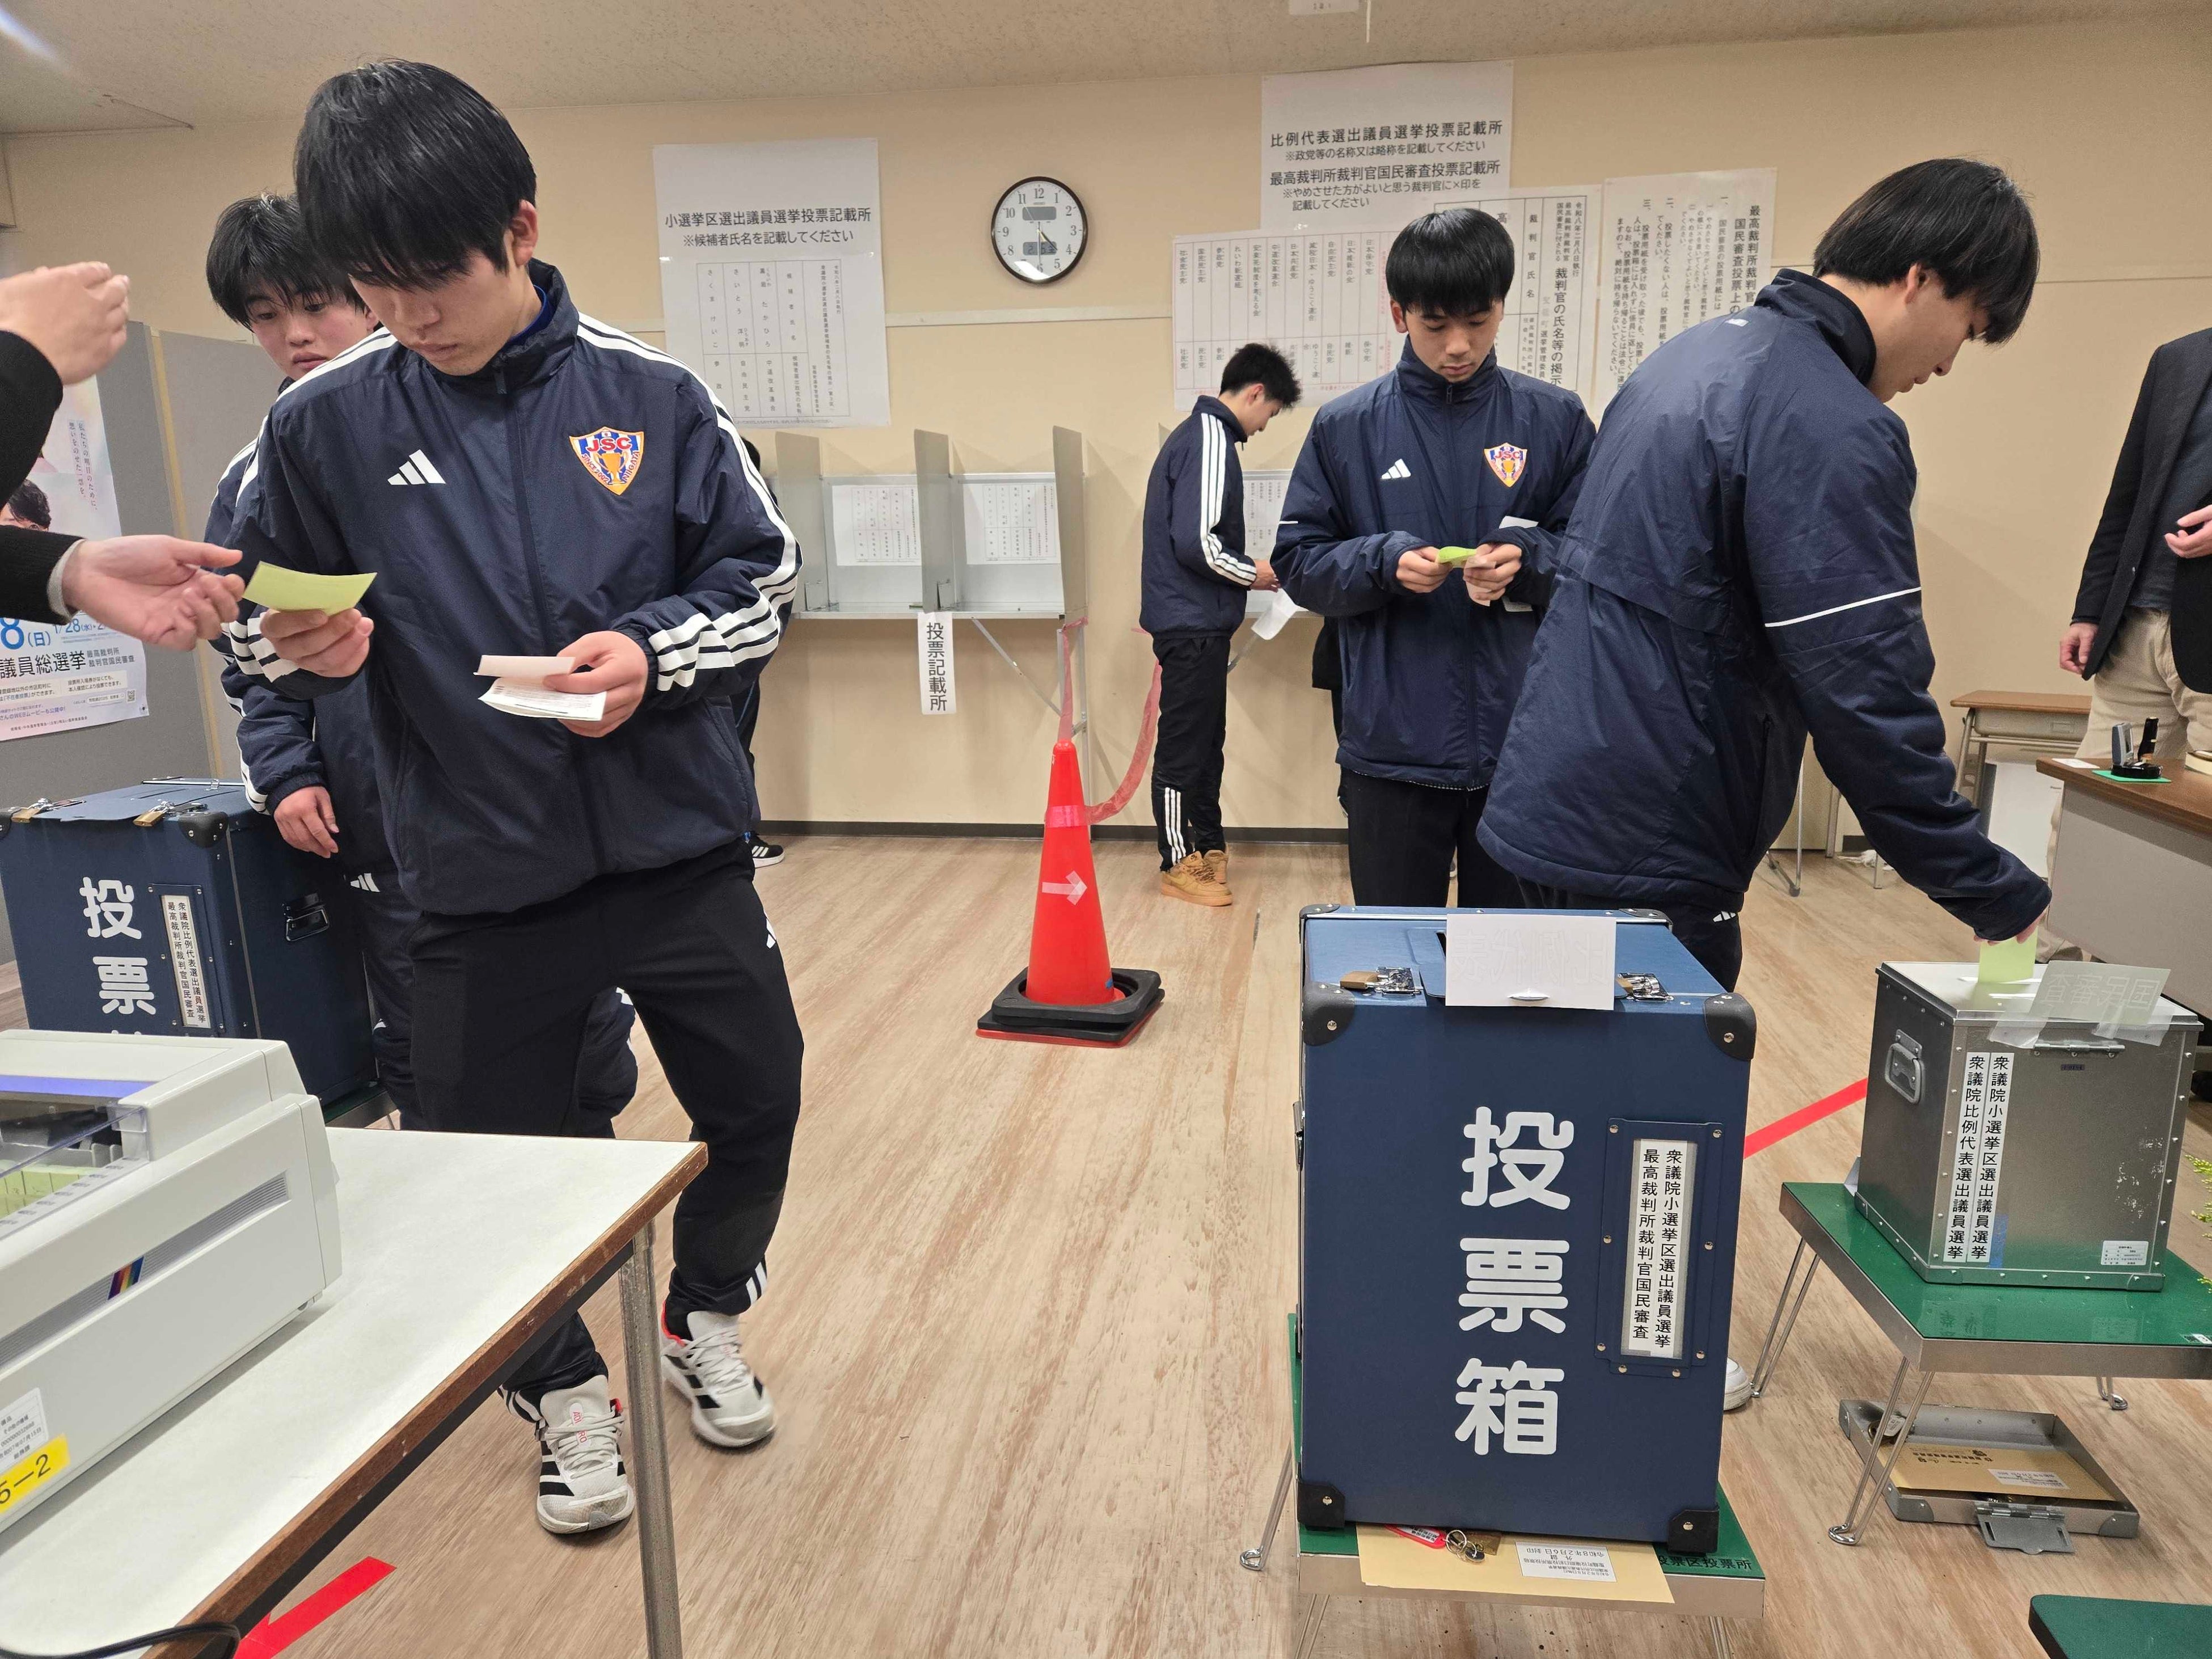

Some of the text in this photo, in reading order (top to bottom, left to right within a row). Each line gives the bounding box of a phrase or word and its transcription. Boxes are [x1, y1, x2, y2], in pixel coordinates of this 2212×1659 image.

[1270, 120, 1502, 147] 比例代表選出議員選挙投票記載所
[1270, 159, 1501, 186] 最高裁判所裁判官国民審査投票記載所
[1018, 193, 1026, 204] 11
[1034, 188, 1044, 199] 12
[1054, 193, 1058, 203] 1
[1293, 199, 1370, 212] 記載してください
[665, 207, 872, 227] 小選挙区選出議員選挙投票記載所
[1005, 208, 1015, 218] 10
[1065, 206, 1072, 216] 2
[1003, 227, 1009, 237] 9
[1070, 225, 1077, 235] 3
[1008, 246, 1014, 255] 8
[1054, 259, 1060, 269] 5
[1066, 244, 1072, 255] 4
[1526, 214, 1538, 298] 裁判官氏名
[1745, 205, 1760, 303] 最高裁判所裁判官
[1730, 218, 1746, 313] 国民審査投票上の
[762, 301, 771, 348] たかひろ
[1551, 267, 1568, 386] 裁判官の氏名等の掲示
[740, 361, 751, 412] 自由民主党
[586, 437, 632, 452] JSC
[1494, 450, 1521, 459] JSC
[581, 454, 610, 484] SINCE 2002
[622, 451, 640, 483] NIIGATA
[0, 650, 86, 679] 議員総選挙
[87, 647, 120, 658] 最高裁判所
[88, 655, 136, 668] 裁判官国民審査
[926, 622, 947, 712] 投票記載所
[79, 877, 156, 1034] 投票
[167, 901, 195, 1018] 最高裁判所裁判官国民審査
[178, 901, 206, 1024] 衆議院比例代表選出議員選挙
[1947, 1056, 1985, 1259] 衆議院比例代表選出議員選挙
[1970, 1056, 2010, 1259] 衆議院小選挙区選出議員選挙
[1632, 1147, 1660, 1340] 最高裁判所裁判官国民審査
[1654, 1148, 1684, 1349] 衆議院小選挙区選出議員選挙
[1454, 1106, 1575, 1456] 投票箱
[573, 1411, 588, 1443] ADIRO
